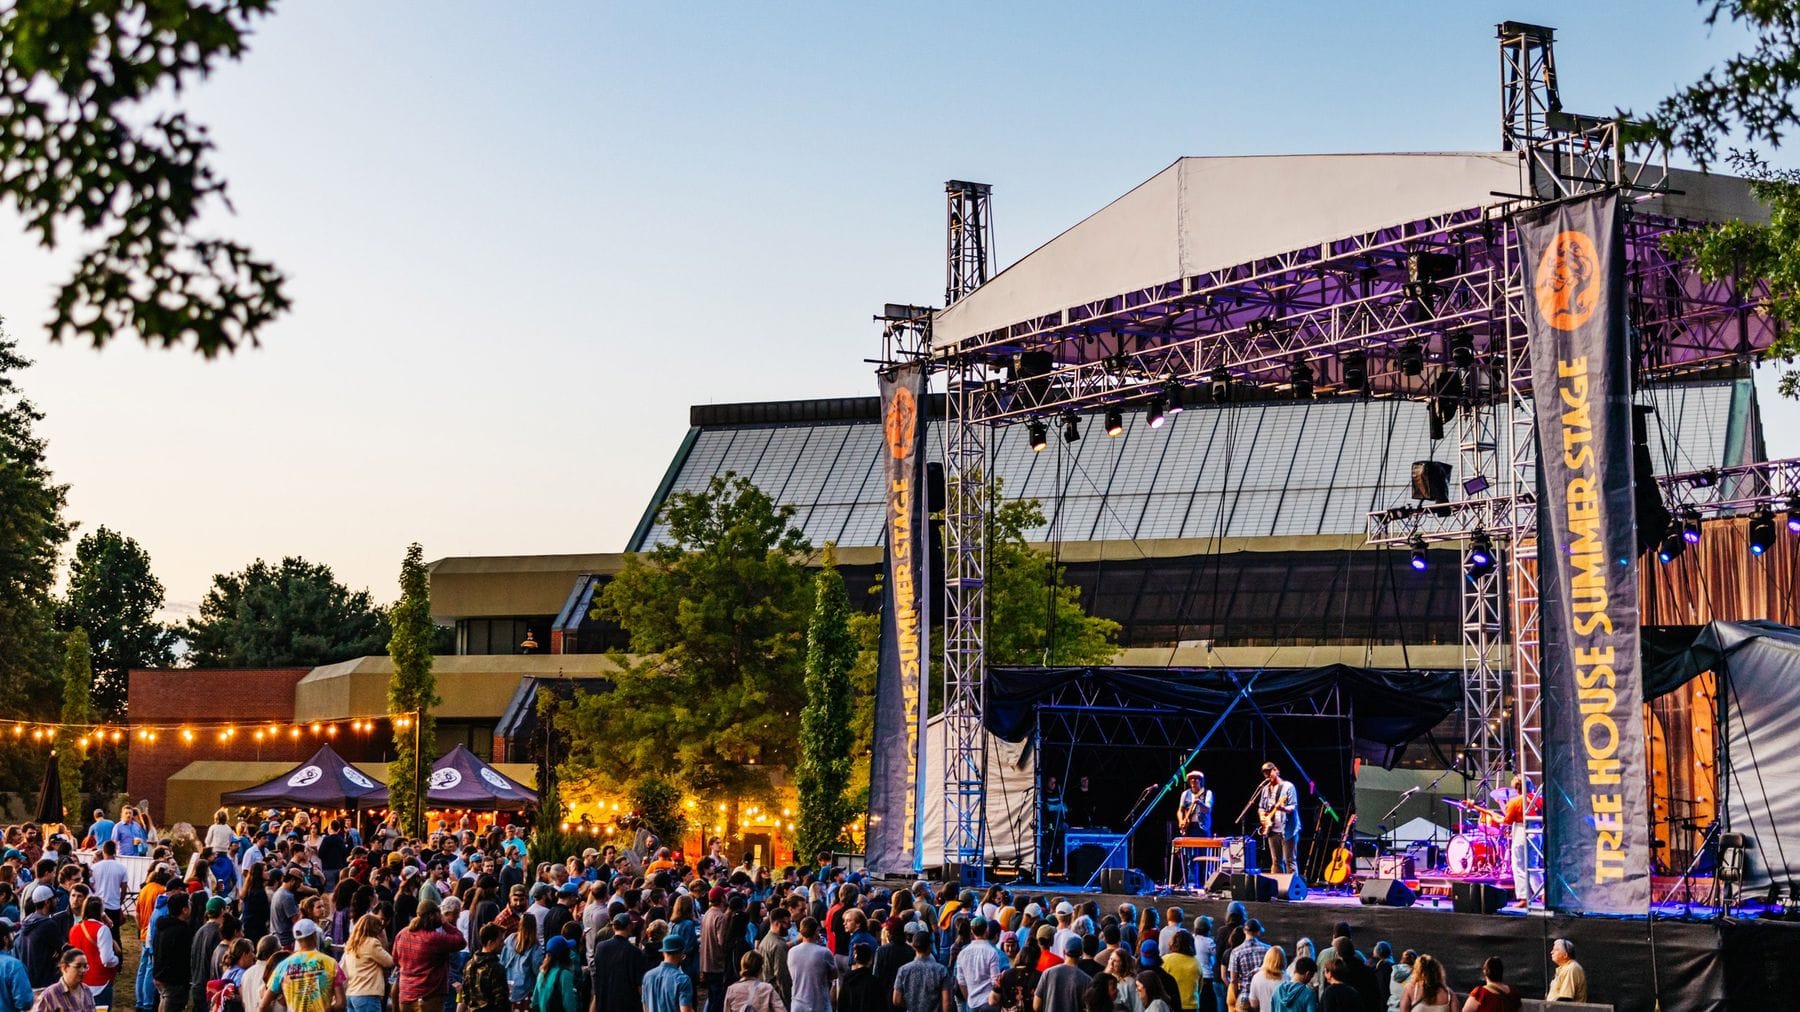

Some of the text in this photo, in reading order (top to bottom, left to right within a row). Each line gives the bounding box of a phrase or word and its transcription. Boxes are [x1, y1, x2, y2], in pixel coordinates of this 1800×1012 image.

[893, 478, 912, 559] STAGE
[896, 564, 919, 677] SUMMER
[1557, 356, 1625, 885] TREE HOUSE SUMMER STAGE
